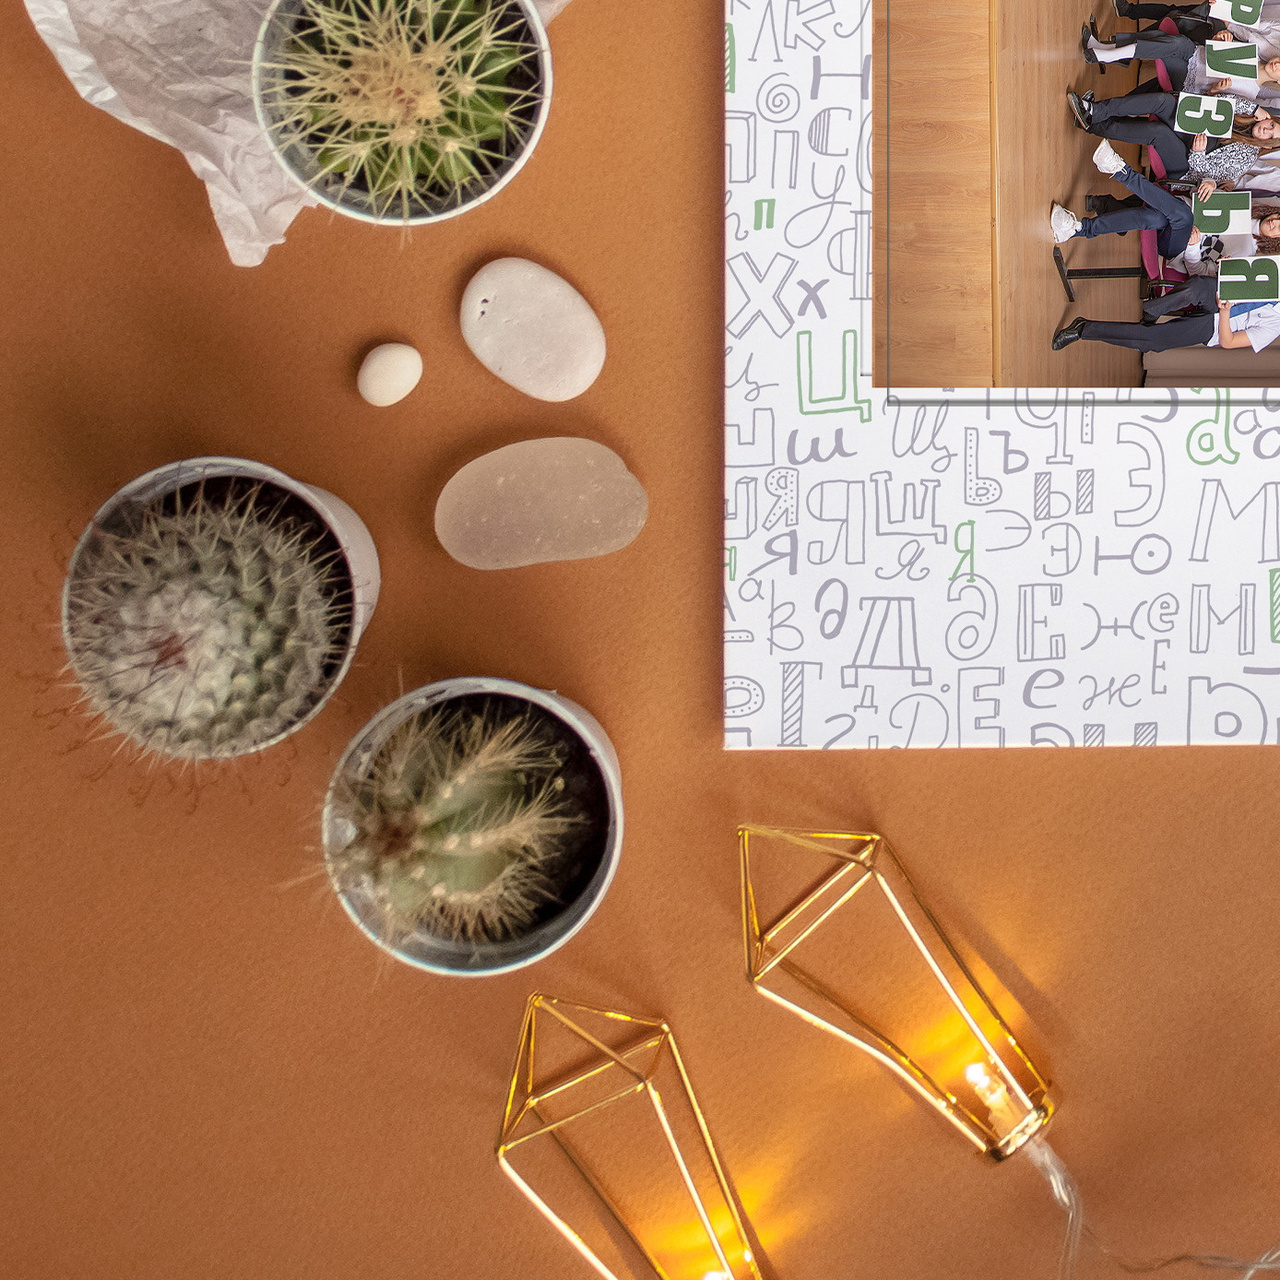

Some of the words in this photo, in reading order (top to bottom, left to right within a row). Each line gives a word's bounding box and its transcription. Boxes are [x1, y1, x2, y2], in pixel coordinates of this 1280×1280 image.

[1207, 45, 1256, 78] У
[1177, 97, 1232, 135] З
[1193, 194, 1249, 233] Ь
[1220, 259, 1278, 300] Я
